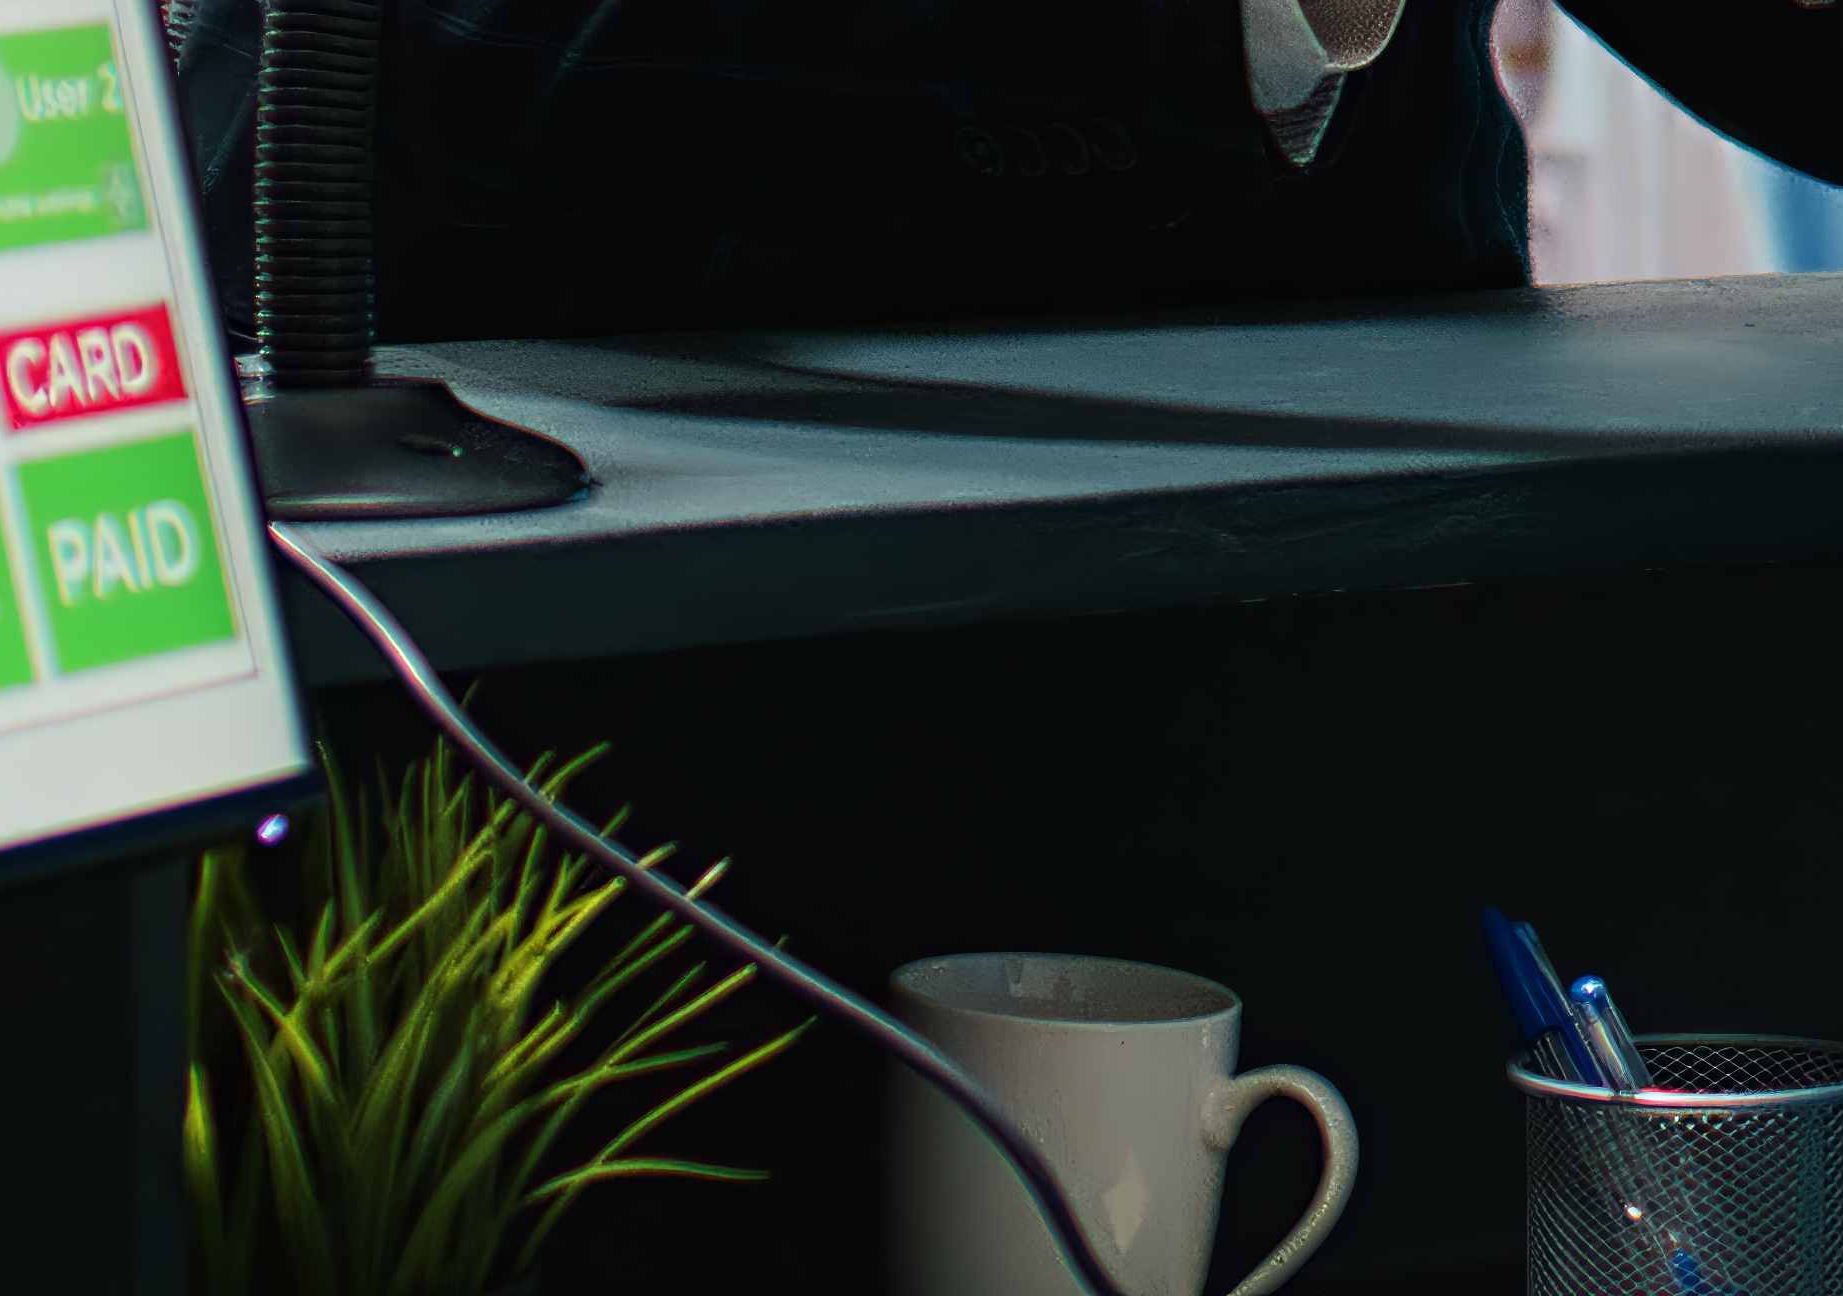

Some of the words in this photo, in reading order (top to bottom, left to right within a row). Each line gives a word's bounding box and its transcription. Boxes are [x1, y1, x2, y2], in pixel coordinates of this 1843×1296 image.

[14, 74, 90, 121] User
[6, 322, 155, 412] CARD
[47, 499, 200, 609] PAID
